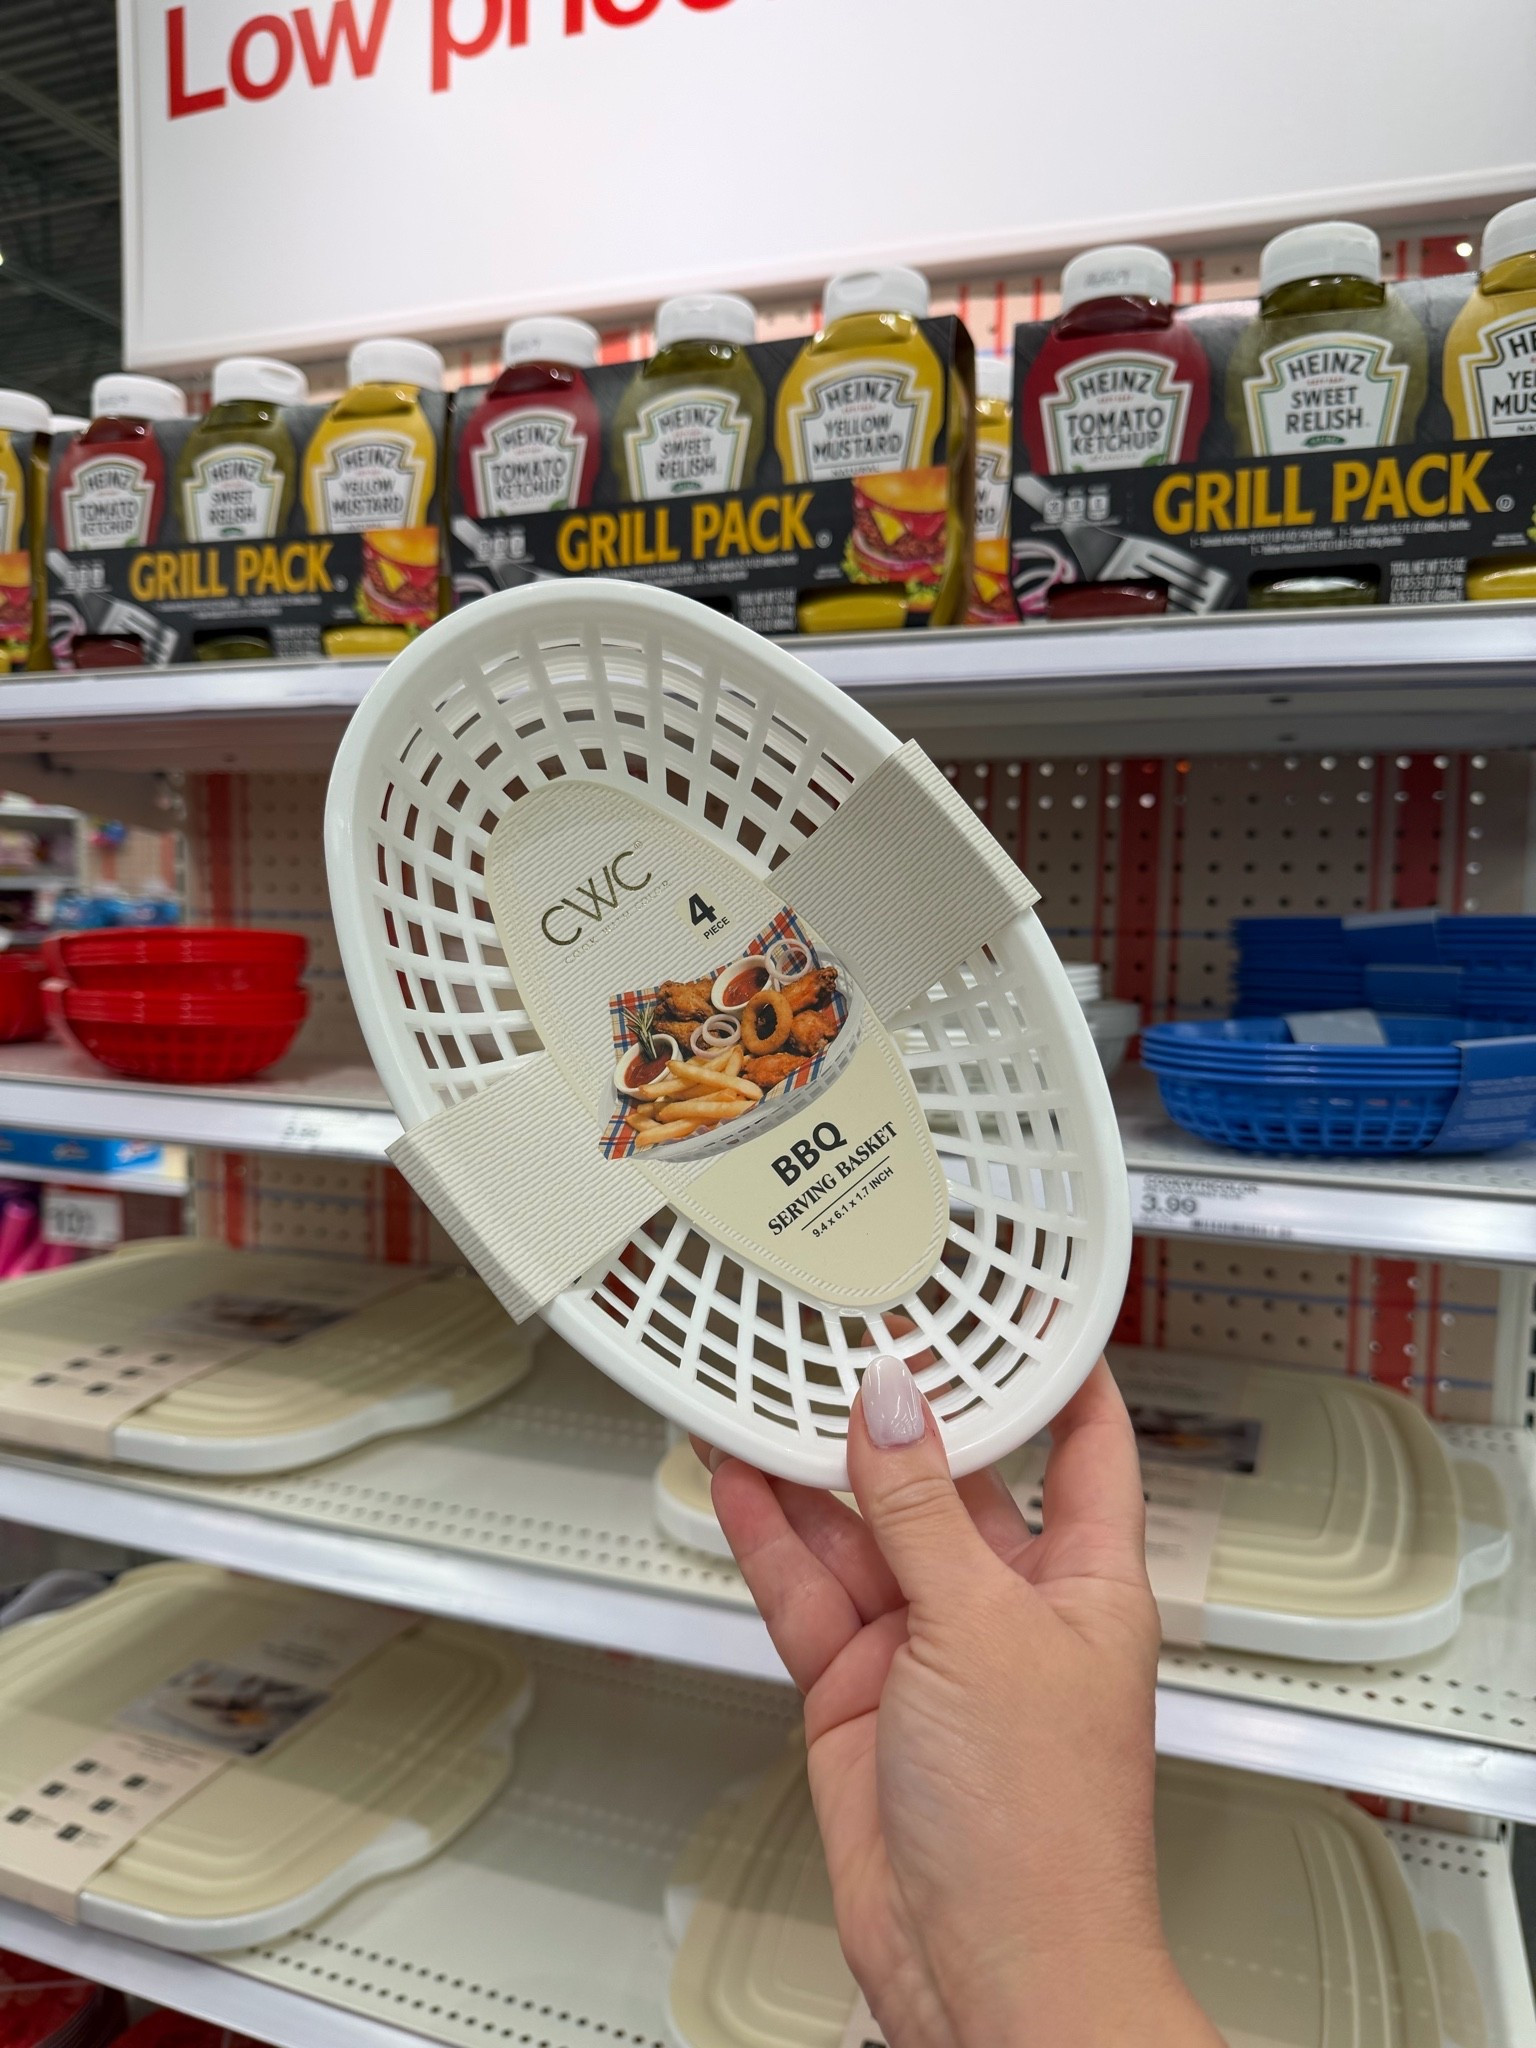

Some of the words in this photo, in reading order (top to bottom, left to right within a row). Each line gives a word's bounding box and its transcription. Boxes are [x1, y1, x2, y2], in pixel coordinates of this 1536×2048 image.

[165, 0, 393, 120] Low
[1287, 352, 1366, 382] HEINZ
[825, 381, 894, 411] HEINZ
[1079, 366, 1154, 400] HEINZ
[1291, 386, 1358, 410] SWEET
[658, 408, 718, 434] HEINZ
[823, 414, 893, 439] YELLOW
[1066, 406, 1165, 438] TOMATO
[1285, 408, 1363, 435] RELISH
[501, 425, 557, 451] HEINZ
[661, 437, 711, 459] SWEET
[812, 434, 902, 464] MUSTARD
[1069, 430, 1160, 456] KETCHUP
[211, 463, 258, 482] HEINZ
[342, 447, 397, 471] HEINZ
[491, 458, 568, 485] TOMATO
[656, 455, 716, 482] RELISH
[87, 470, 132, 491] HEINZ
[341, 478, 393, 497] YELLOW
[495, 478, 563, 501] KETCHUP
[1153, 463, 1316, 537] GRILL
[1331, 450, 1494, 524] PACK
[332, 495, 404, 516] MUSTARD
[556, 505, 681, 573] GRILL
[692, 490, 816, 559] PACK
[130, 549, 229, 602] GRILL
[236, 541, 334, 597] PACK
[688, 892, 718, 927] 4
[703, 916, 730, 940] PIECE
[770, 1122, 848, 1187] BBQ
[768, 1173, 837, 1236] SERVING
[834, 1121, 898, 1179] BASKET
[812, 1222, 828, 1238] 9.4
[834, 1205, 849, 1220] 6.1
[855, 1186, 870, 1201] 1.7
[868, 1166, 894, 1190] INCH
